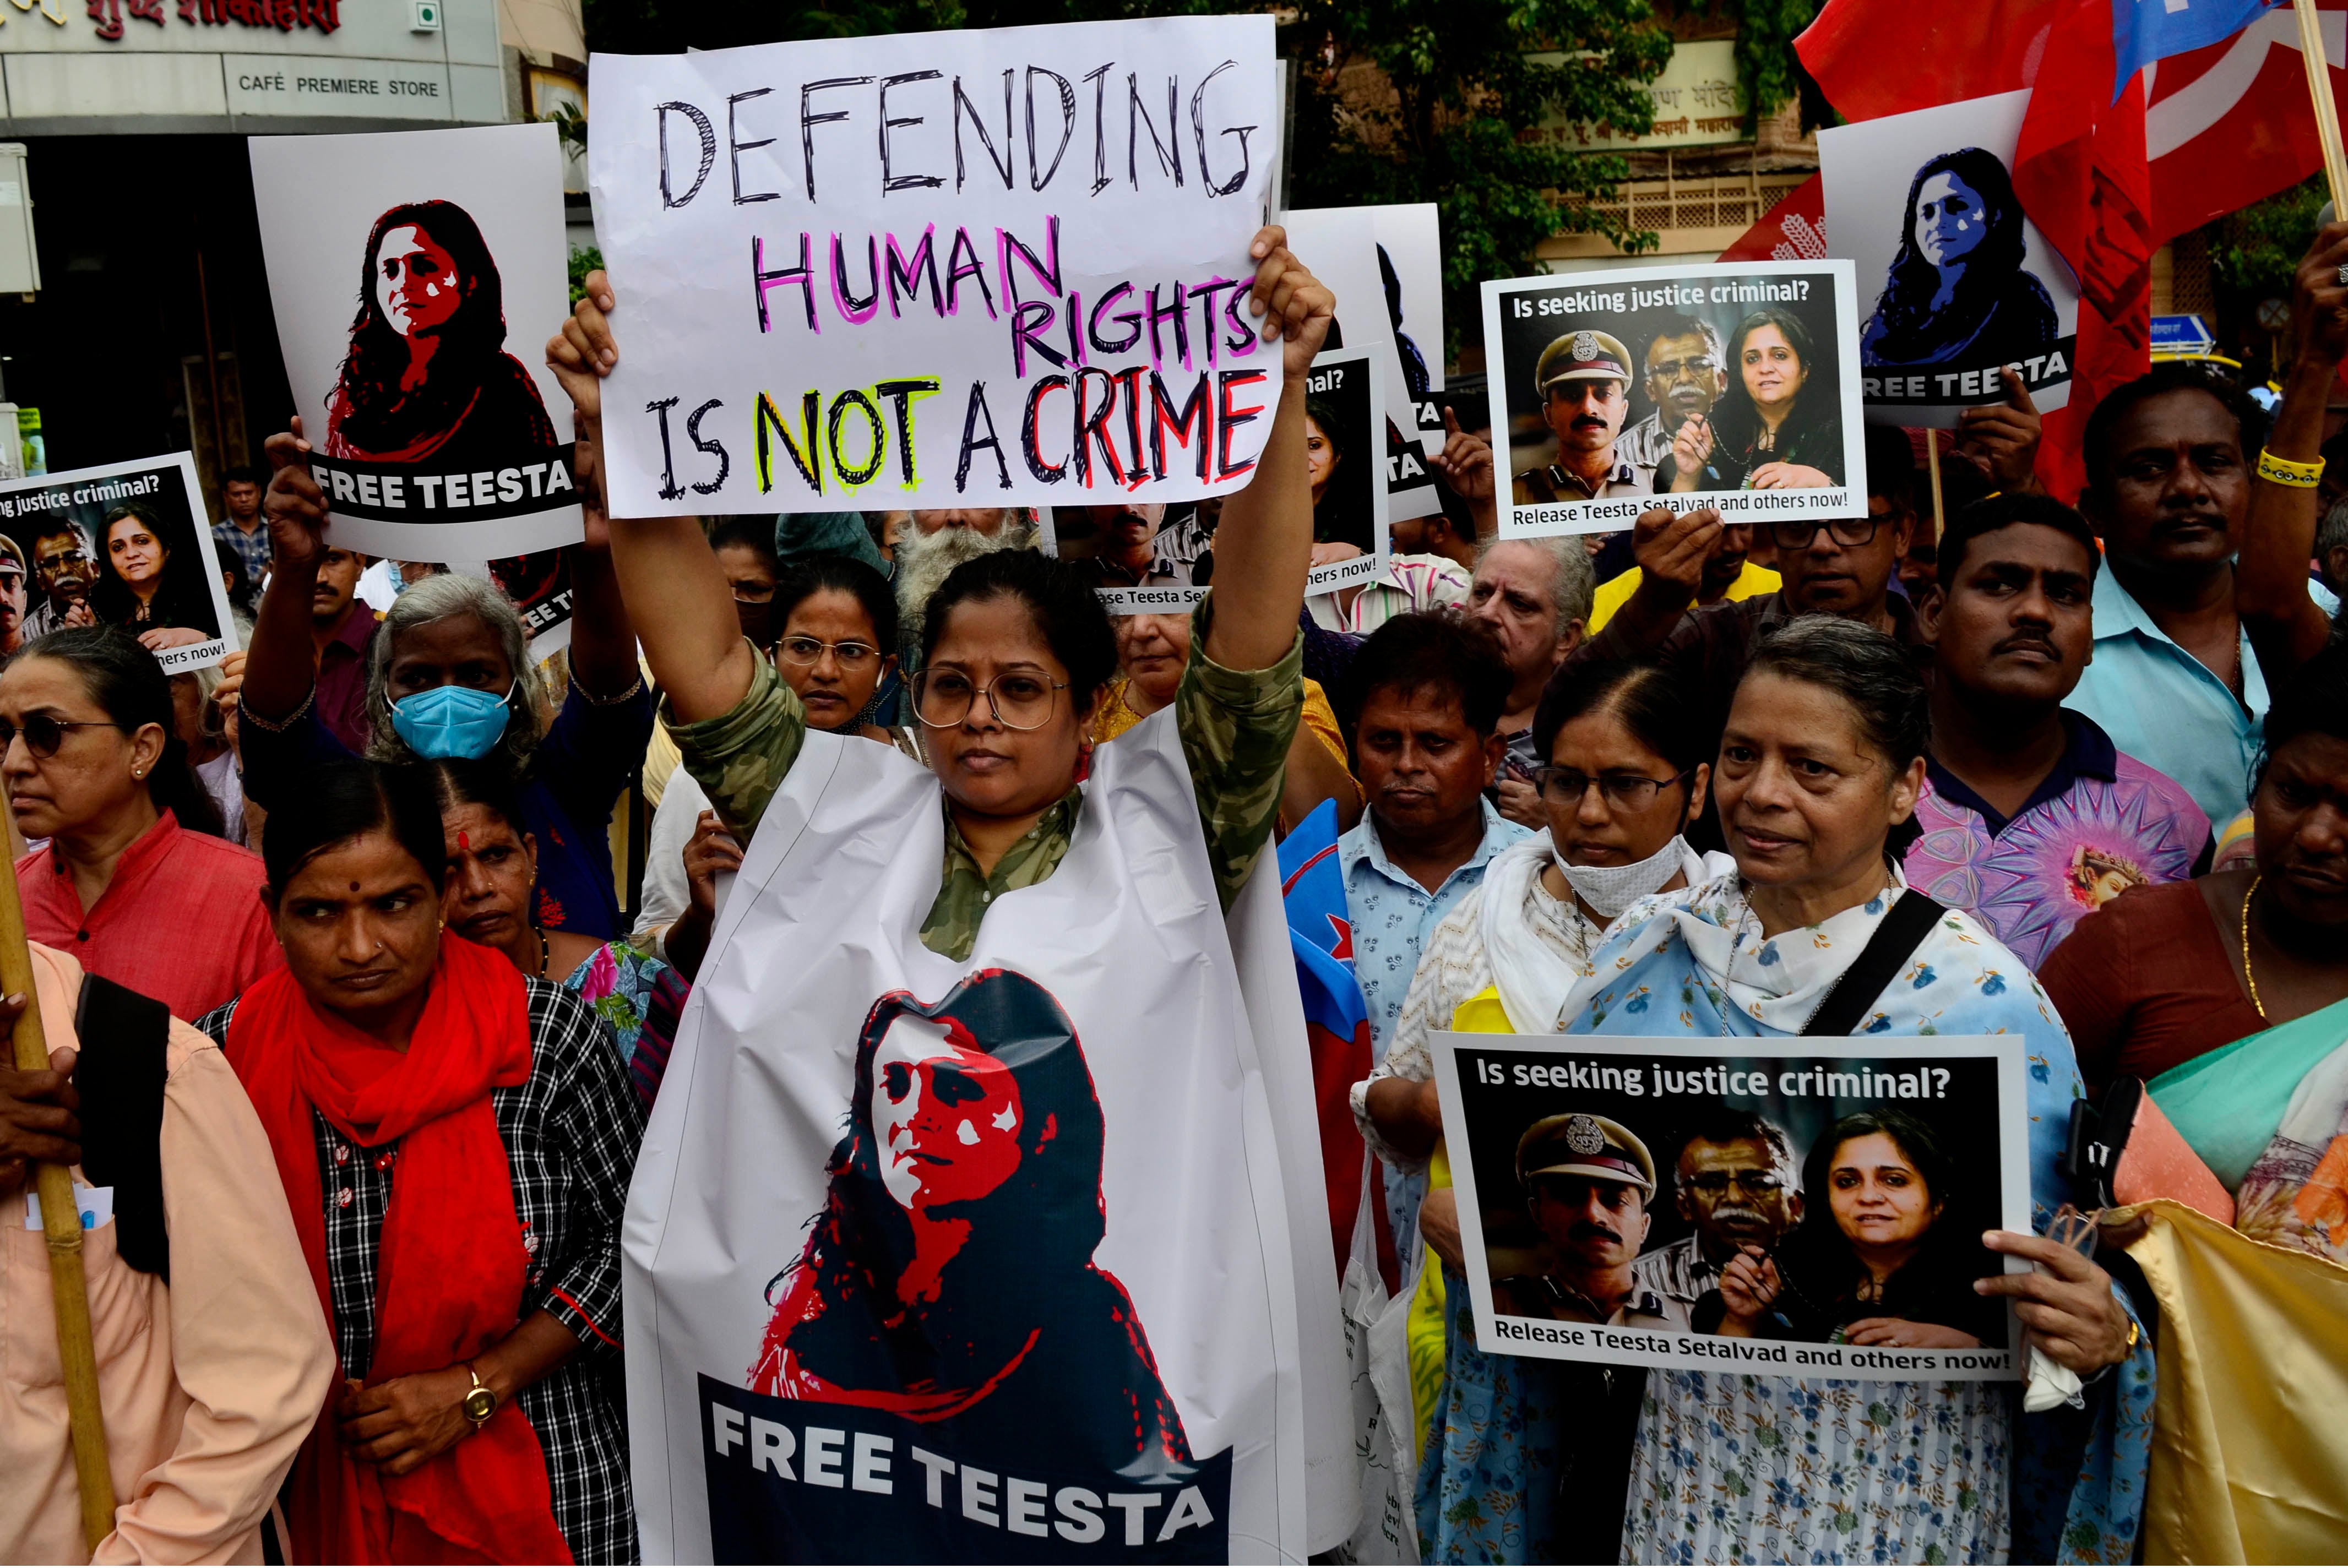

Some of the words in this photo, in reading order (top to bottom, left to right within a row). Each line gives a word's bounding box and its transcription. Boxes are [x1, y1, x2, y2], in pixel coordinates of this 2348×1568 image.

[240, 71, 285, 90] CAFÉ
[297, 78, 379, 95] PREMIERE
[389, 80, 439, 97] STORE
[654, 60, 1258, 211] DEFENDING
[752, 215, 1063, 335] HUMAN
[1514, 298, 1532, 318] Is
[1538, 291, 1627, 317] seeking
[1630, 284, 1705, 312] justice
[1710, 279, 1810, 304] criminal?
[1011, 275, 1265, 378] RIGHTS
[1862, 376, 1926, 397] REE
[645, 396, 731, 502] IS
[754, 374, 941, 498] NOT
[955, 380, 1014, 492] A
[1020, 365, 1268, 493] CRIME
[15, 491, 70, 516] justice
[73, 475, 159, 505] criminal?
[312, 464, 406, 508] FREE
[414, 459, 573, 509] TEESTA
[1513, 508, 1577, 525] Release
[1583, 504, 1638, 520] Teesta
[1721, 494, 1748, 510] and
[1754, 493, 1805, 509] others
[1809, 491, 1848, 507] now!
[1342, 557, 1376, 578] now!
[524, 603, 557, 628] EE
[1127, 591, 1180, 603] Teesta
[1183, 590, 1206, 602] Se
[191, 642, 226, 660] now!
[1477, 1059, 1504, 1085] Is
[1514, 1060, 1645, 1095] seeking
[1653, 1065, 1769, 1098] justice
[1779, 1066, 1951, 1101] criminal?
[1496, 1320, 1585, 1347] Release
[1590, 1330, 1671, 1355] Teesta
[1678, 1337, 1787, 1363] Setalvad
[1795, 1347, 1841, 1368] and
[1850, 1350, 1937, 1370] others
[1943, 1351, 2011, 1370] now!
[712, 1401, 894, 1495] FREE
[912, 1445, 1214, 1546] TEESTA
